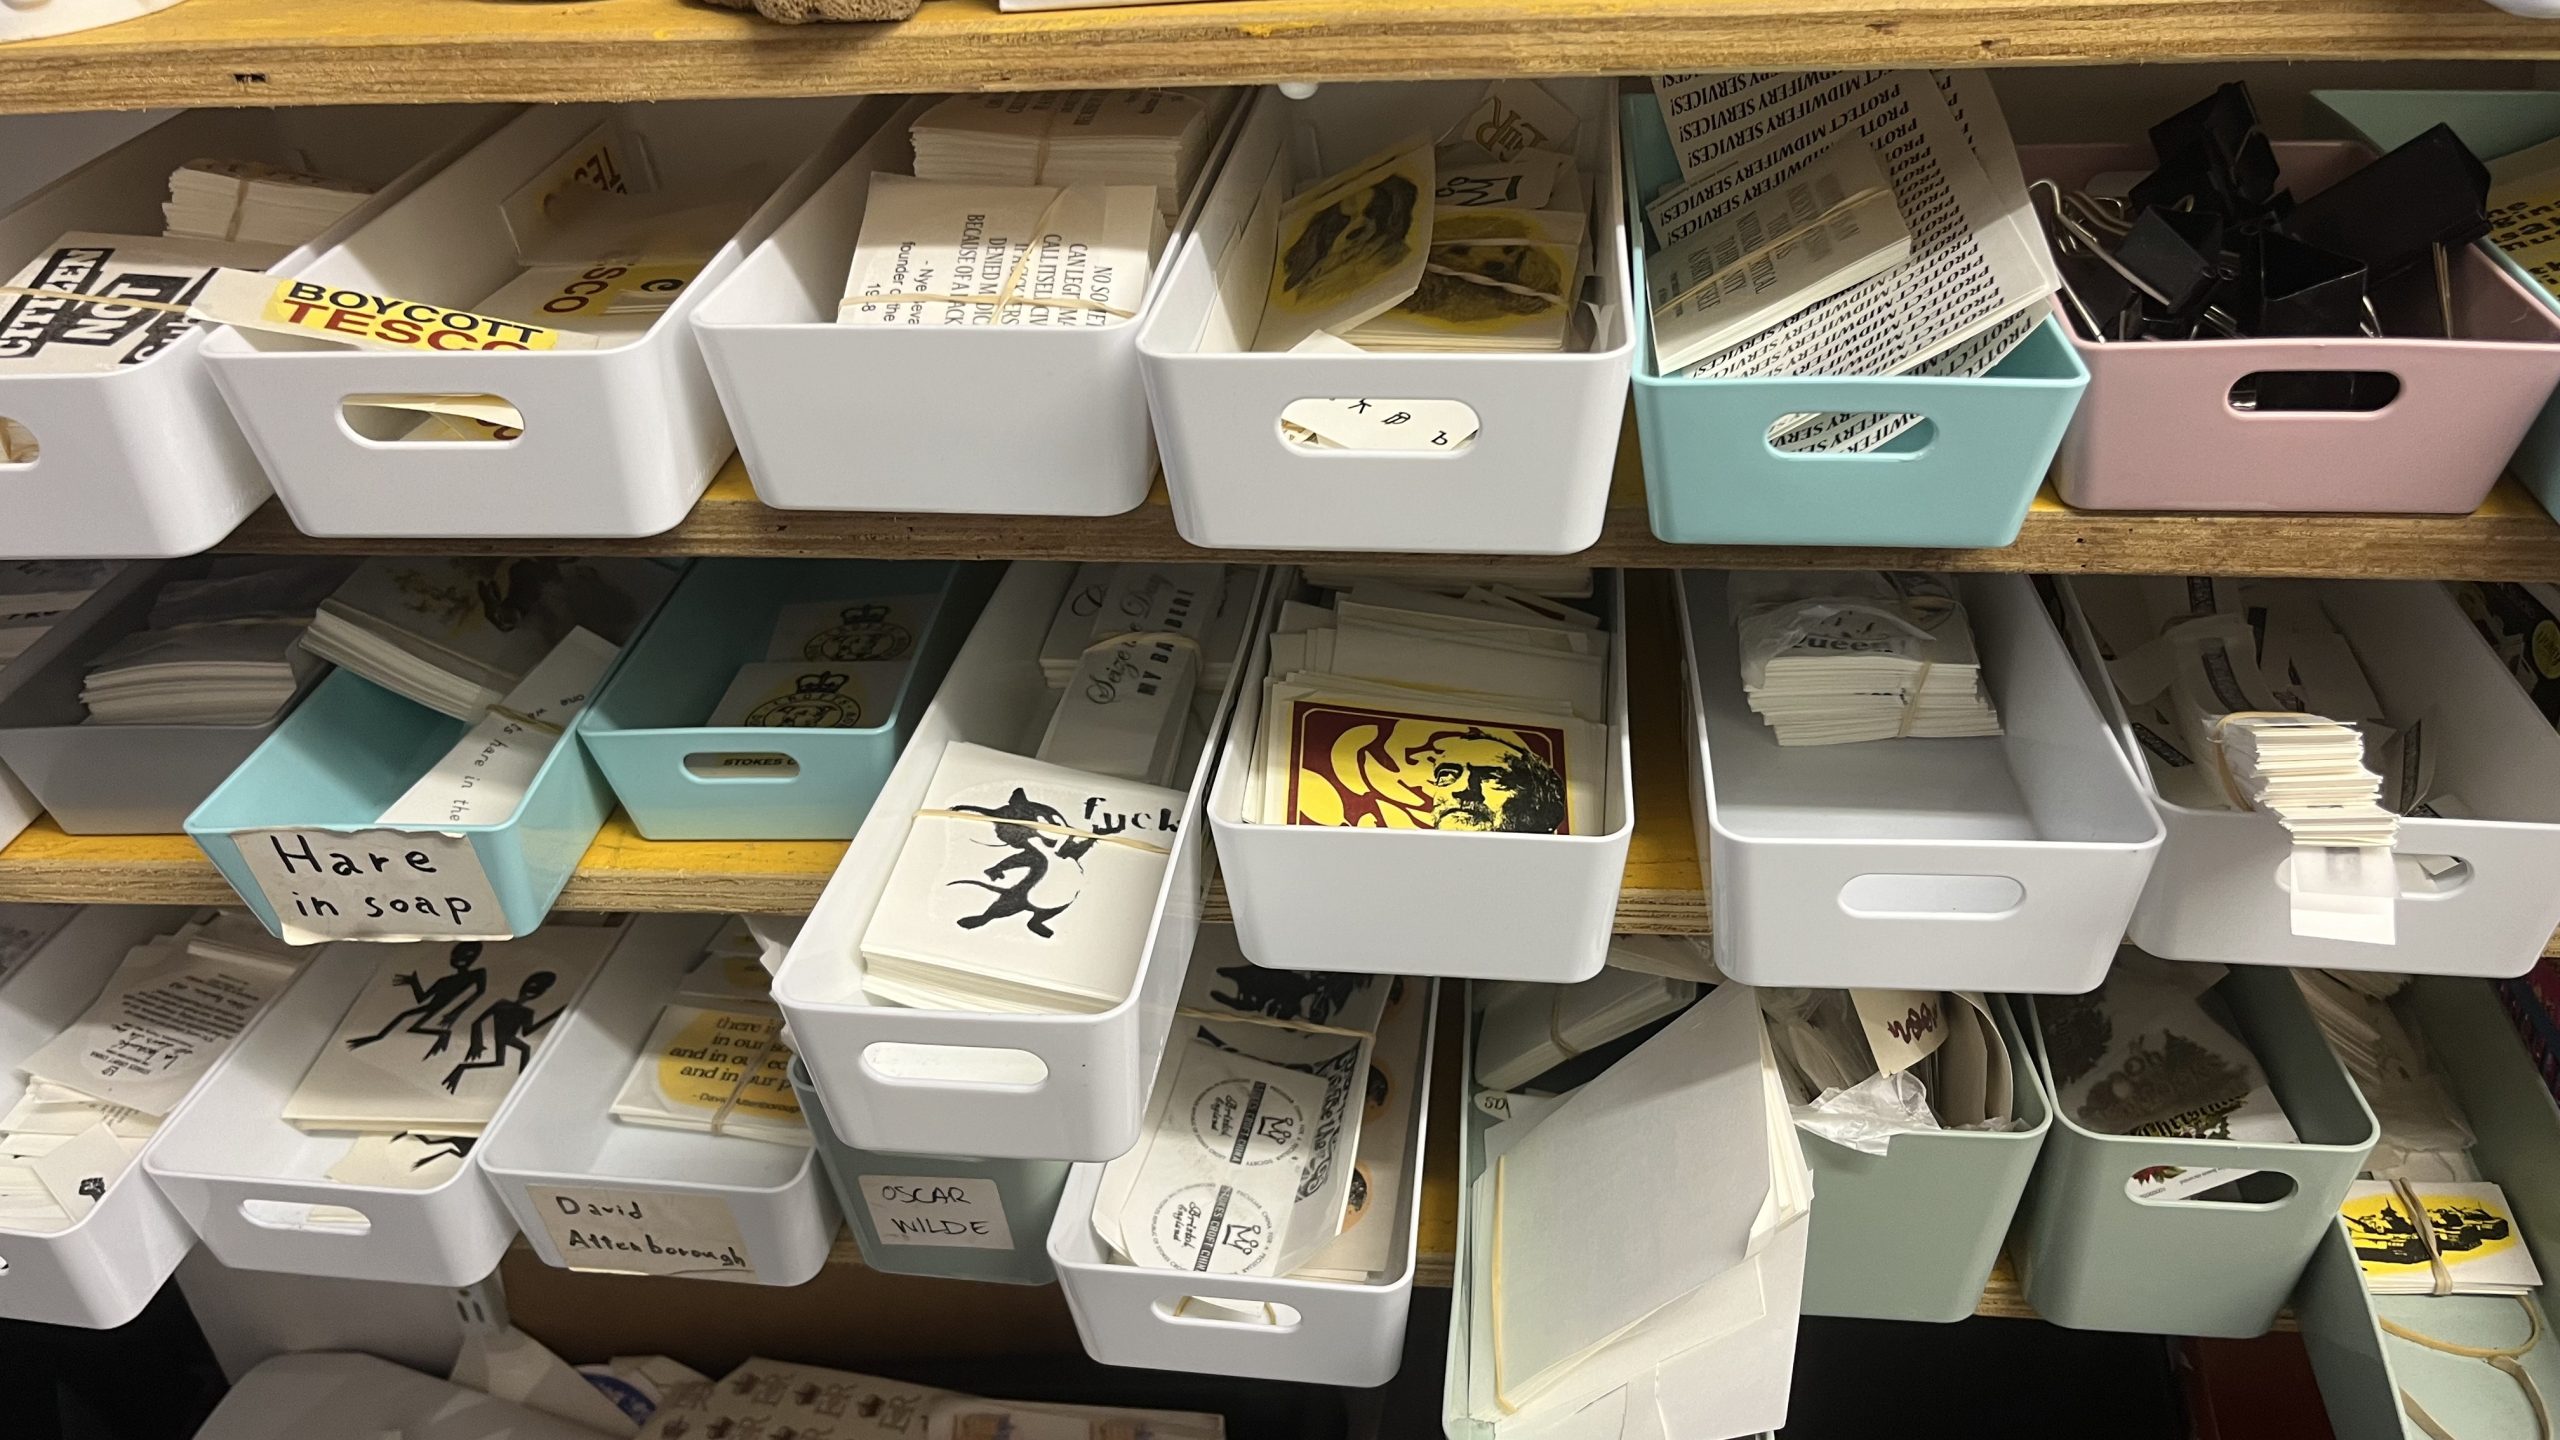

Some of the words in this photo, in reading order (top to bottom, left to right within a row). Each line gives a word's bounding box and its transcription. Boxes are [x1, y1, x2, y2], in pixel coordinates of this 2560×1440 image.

[1675, 97, 1757, 143] SERVICES!
[1762, 75, 1863, 133] MIDWIFERY
[1826, 83, 1902, 133] PROTECT
[1684, 121, 1766, 169] SERVICES!
[1730, 124, 1829, 186] MIDWIFERY
[1657, 175, 1735, 227] SERVICES!
[1664, 194, 1743, 246] SERVICES!
[958, 213, 986, 265] BECAUSE
[981, 237, 1008, 281] DENIED
[1067, 243, 1088, 270] CAN
[892, 240, 916, 286] founder
[919, 267, 935, 293] Nye
[955, 265, 974, 282] OF
[1094, 266, 1113, 282] NO
[1890, 233, 1975, 291] PROTECT
[1894, 243, 1980, 302] PROTECT
[0, 249, 104, 358] CITIZEN
[861, 282, 882, 313] 198
[1897, 254, 1986, 313] PROTECT
[1900, 265, 1991, 324] PROTECT
[62, 283, 161, 340] NOT
[287, 281, 544, 343] BOYCOTT
[883, 303, 897, 323] the
[1781, 287, 1891, 357] MIDWIFERY
[1904, 275, 1996, 334] PROTECT
[1906, 287, 2002, 345] PROTECT
[1784, 298, 1896, 369] MIDWIFERY
[474, 738, 510, 768] hare
[722, 758, 785, 767] STOKES
[461, 774, 481, 790] in
[449, 799, 471, 822] the
[1082, 795, 1184, 835] fuck
[270, 835, 438, 876] Hare
[293, 891, 341, 918] in
[366, 893, 473, 926] soap
[711, 1032, 731, 1047] in
[733, 1037, 765, 1050] our
[715, 1016, 762, 1033] there
[668, 1046, 707, 1061] and
[708, 1049, 727, 1064] in
[679, 1065, 720, 1080] and
[720, 1067, 739, 1082] in
[1230, 1137, 1248, 1164] CHINA
[555, 1195, 643, 1220] David
[881, 1185, 972, 1205] OSCAR
[891, 1217, 990, 1236] WILDE
[1184, 1201, 1202, 1249] Bristol
[1206, 1220, 1221, 1248] CROFT
[568, 1229, 748, 1269] Attenborough
